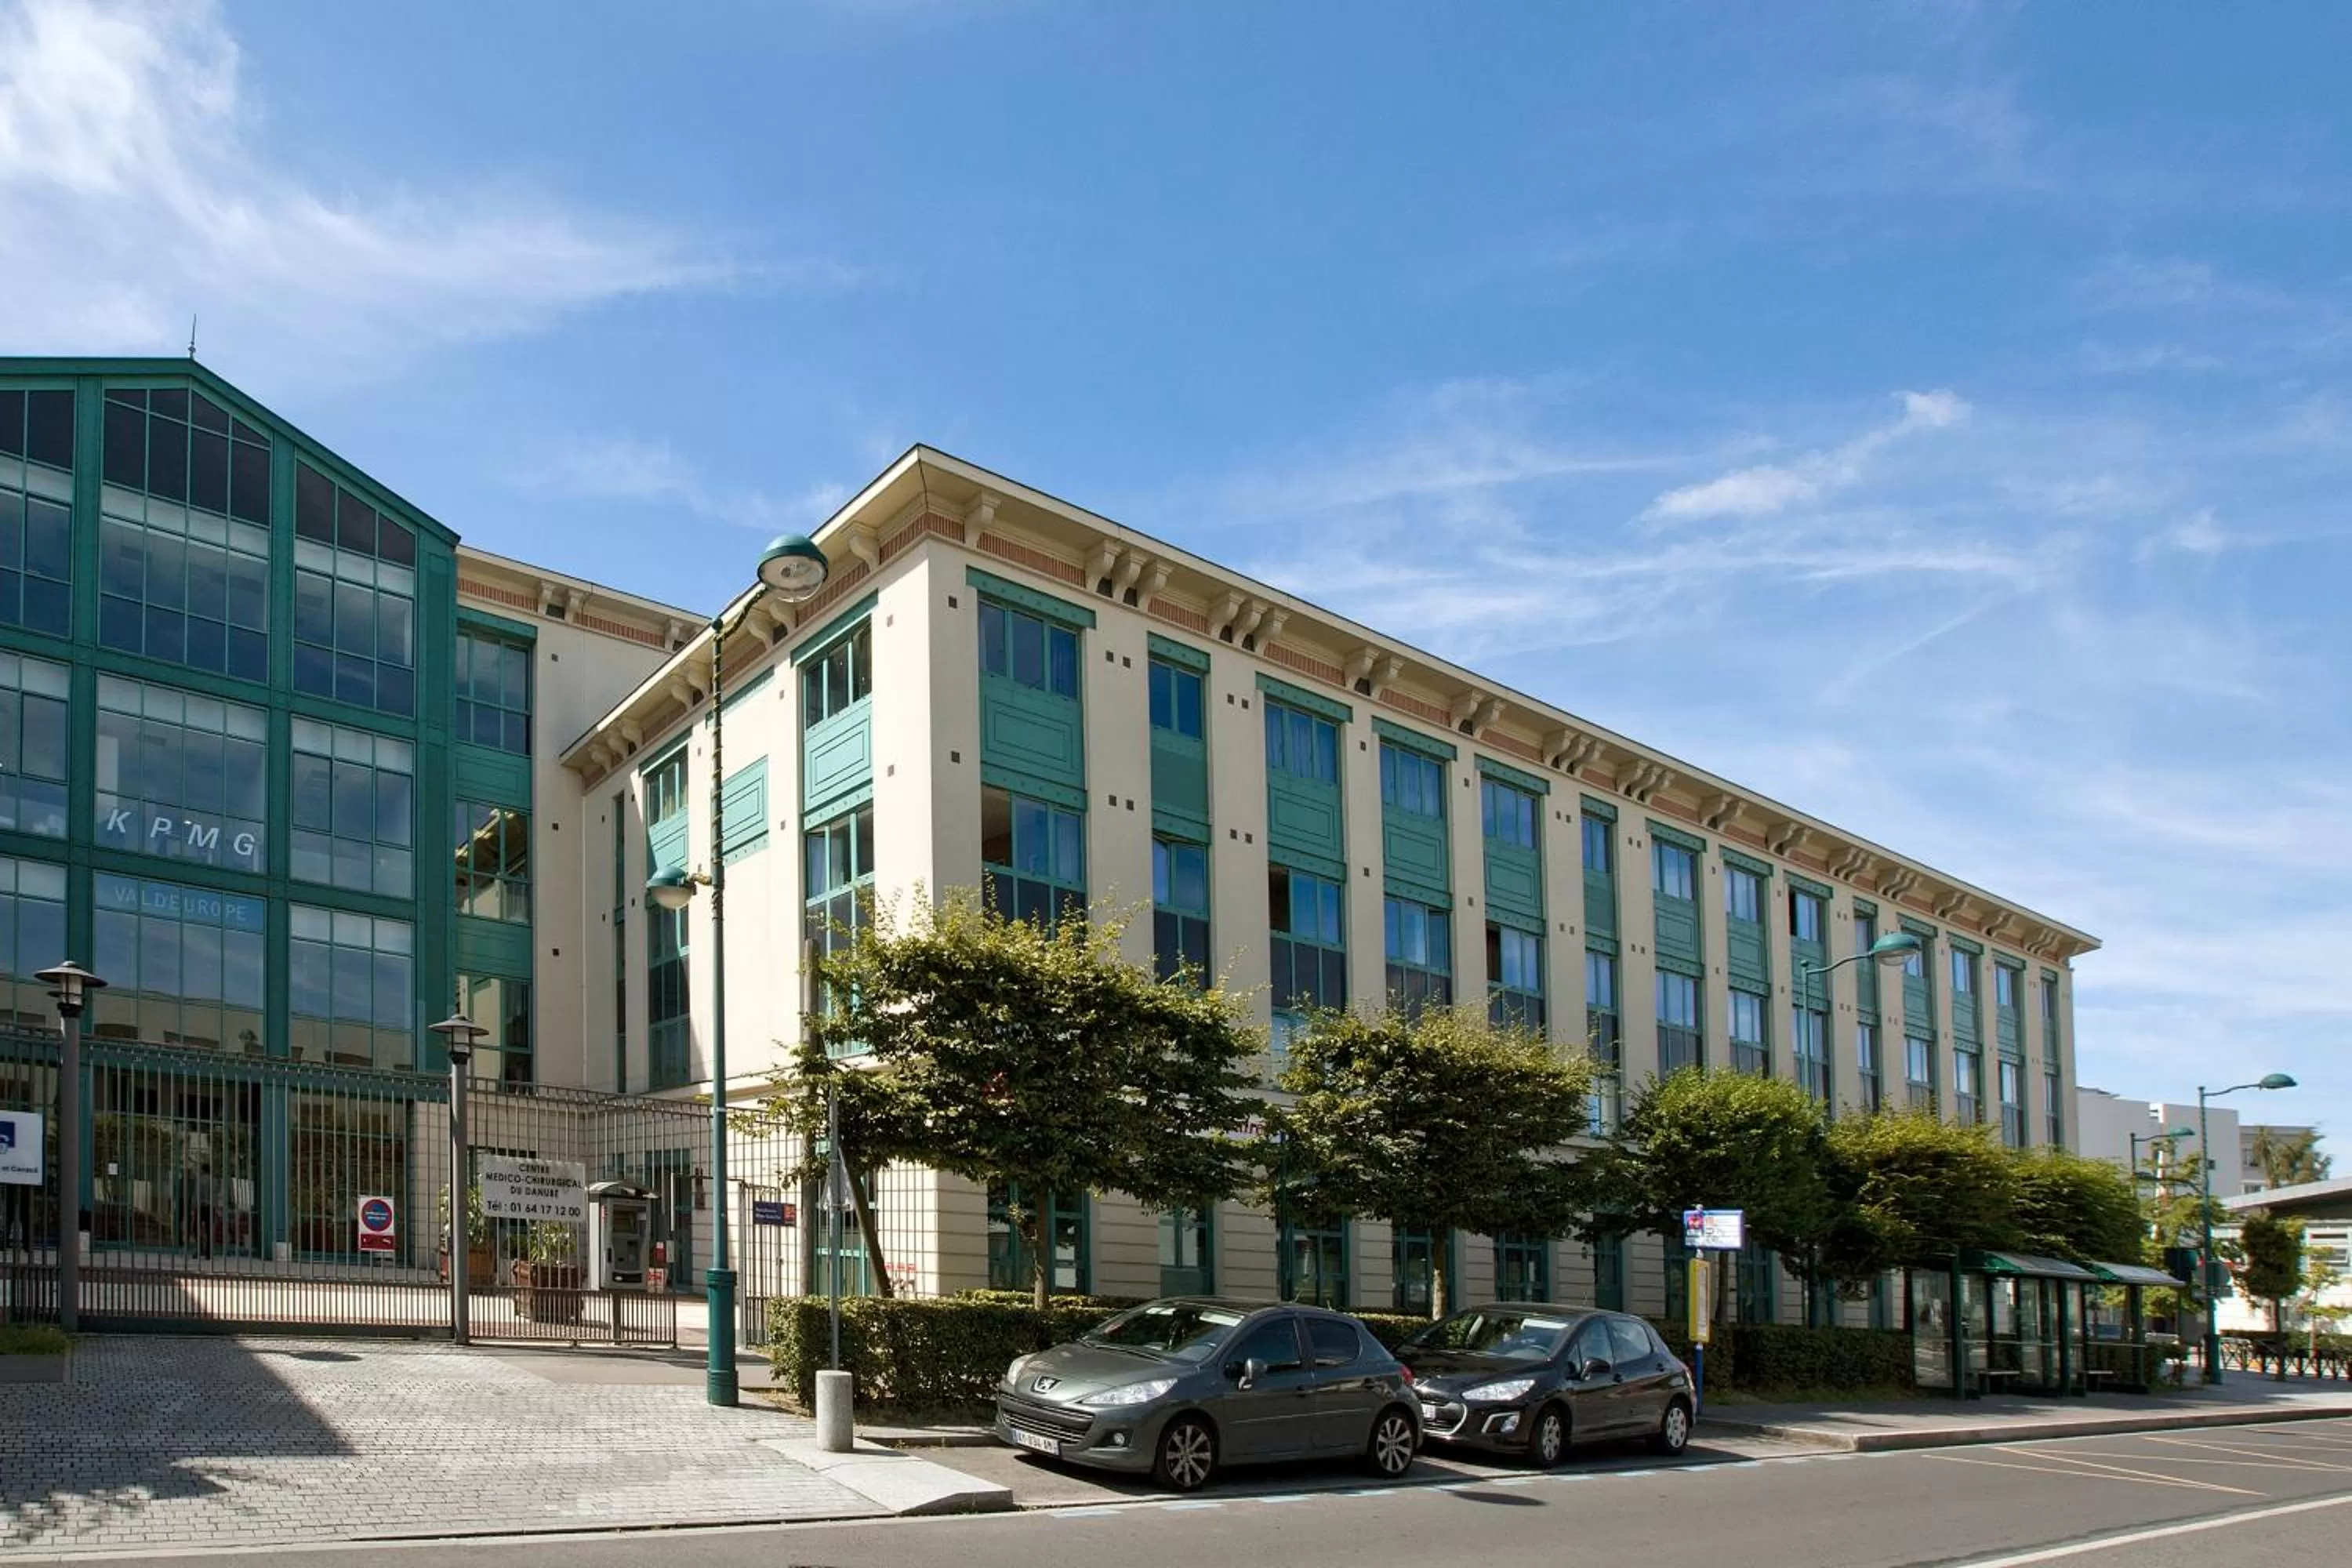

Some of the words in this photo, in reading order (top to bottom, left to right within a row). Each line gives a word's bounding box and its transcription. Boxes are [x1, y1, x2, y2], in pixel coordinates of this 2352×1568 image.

[107, 808, 256, 856] KPMG
[518, 1163, 550, 1174] CENTRE
[510, 1186, 522, 1196] DU
[524, 1187, 559, 1199] DANUBE
[510, 1202, 522, 1213] 01
[525, 1203, 537, 1214] 64
[541, 1204, 553, 1214] 17
[555, 1205, 566, 1216] 12
[568, 1207, 581, 1218] 00
